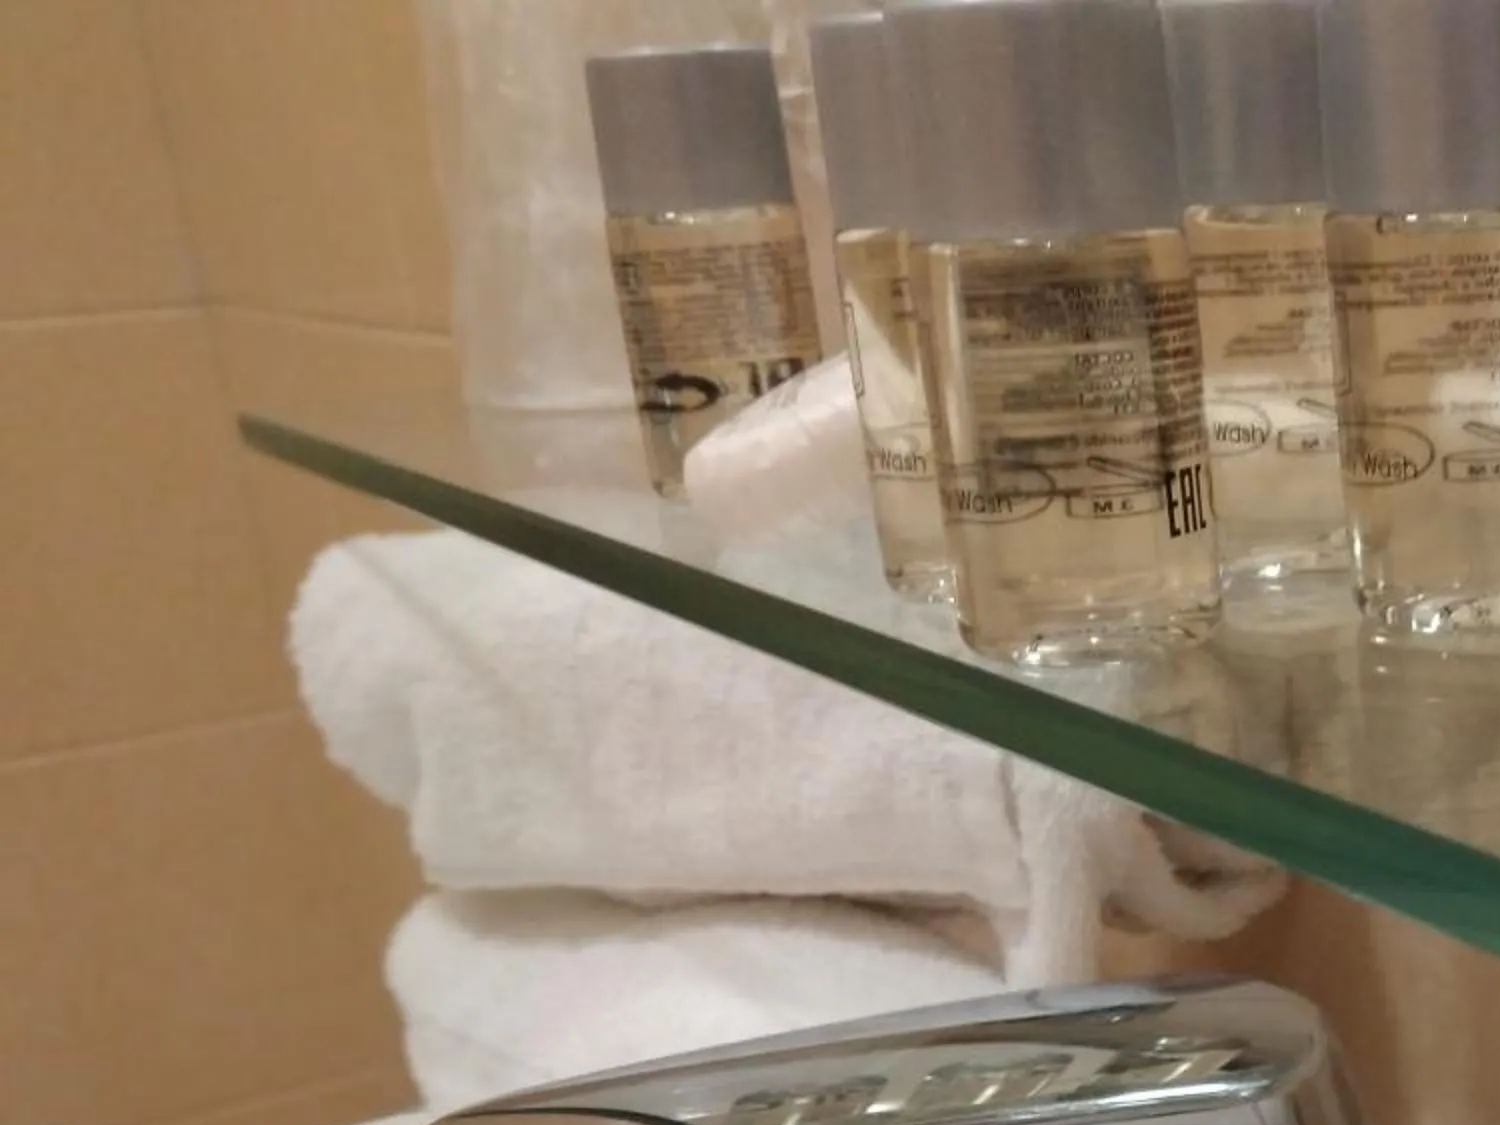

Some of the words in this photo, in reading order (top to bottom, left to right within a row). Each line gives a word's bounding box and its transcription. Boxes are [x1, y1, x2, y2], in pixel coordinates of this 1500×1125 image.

[1213, 422, 1266, 444] Wash
[879, 448, 927, 473] Wash
[1363, 453, 1418, 481] Wash
[957, 489, 1013, 514] Wash
